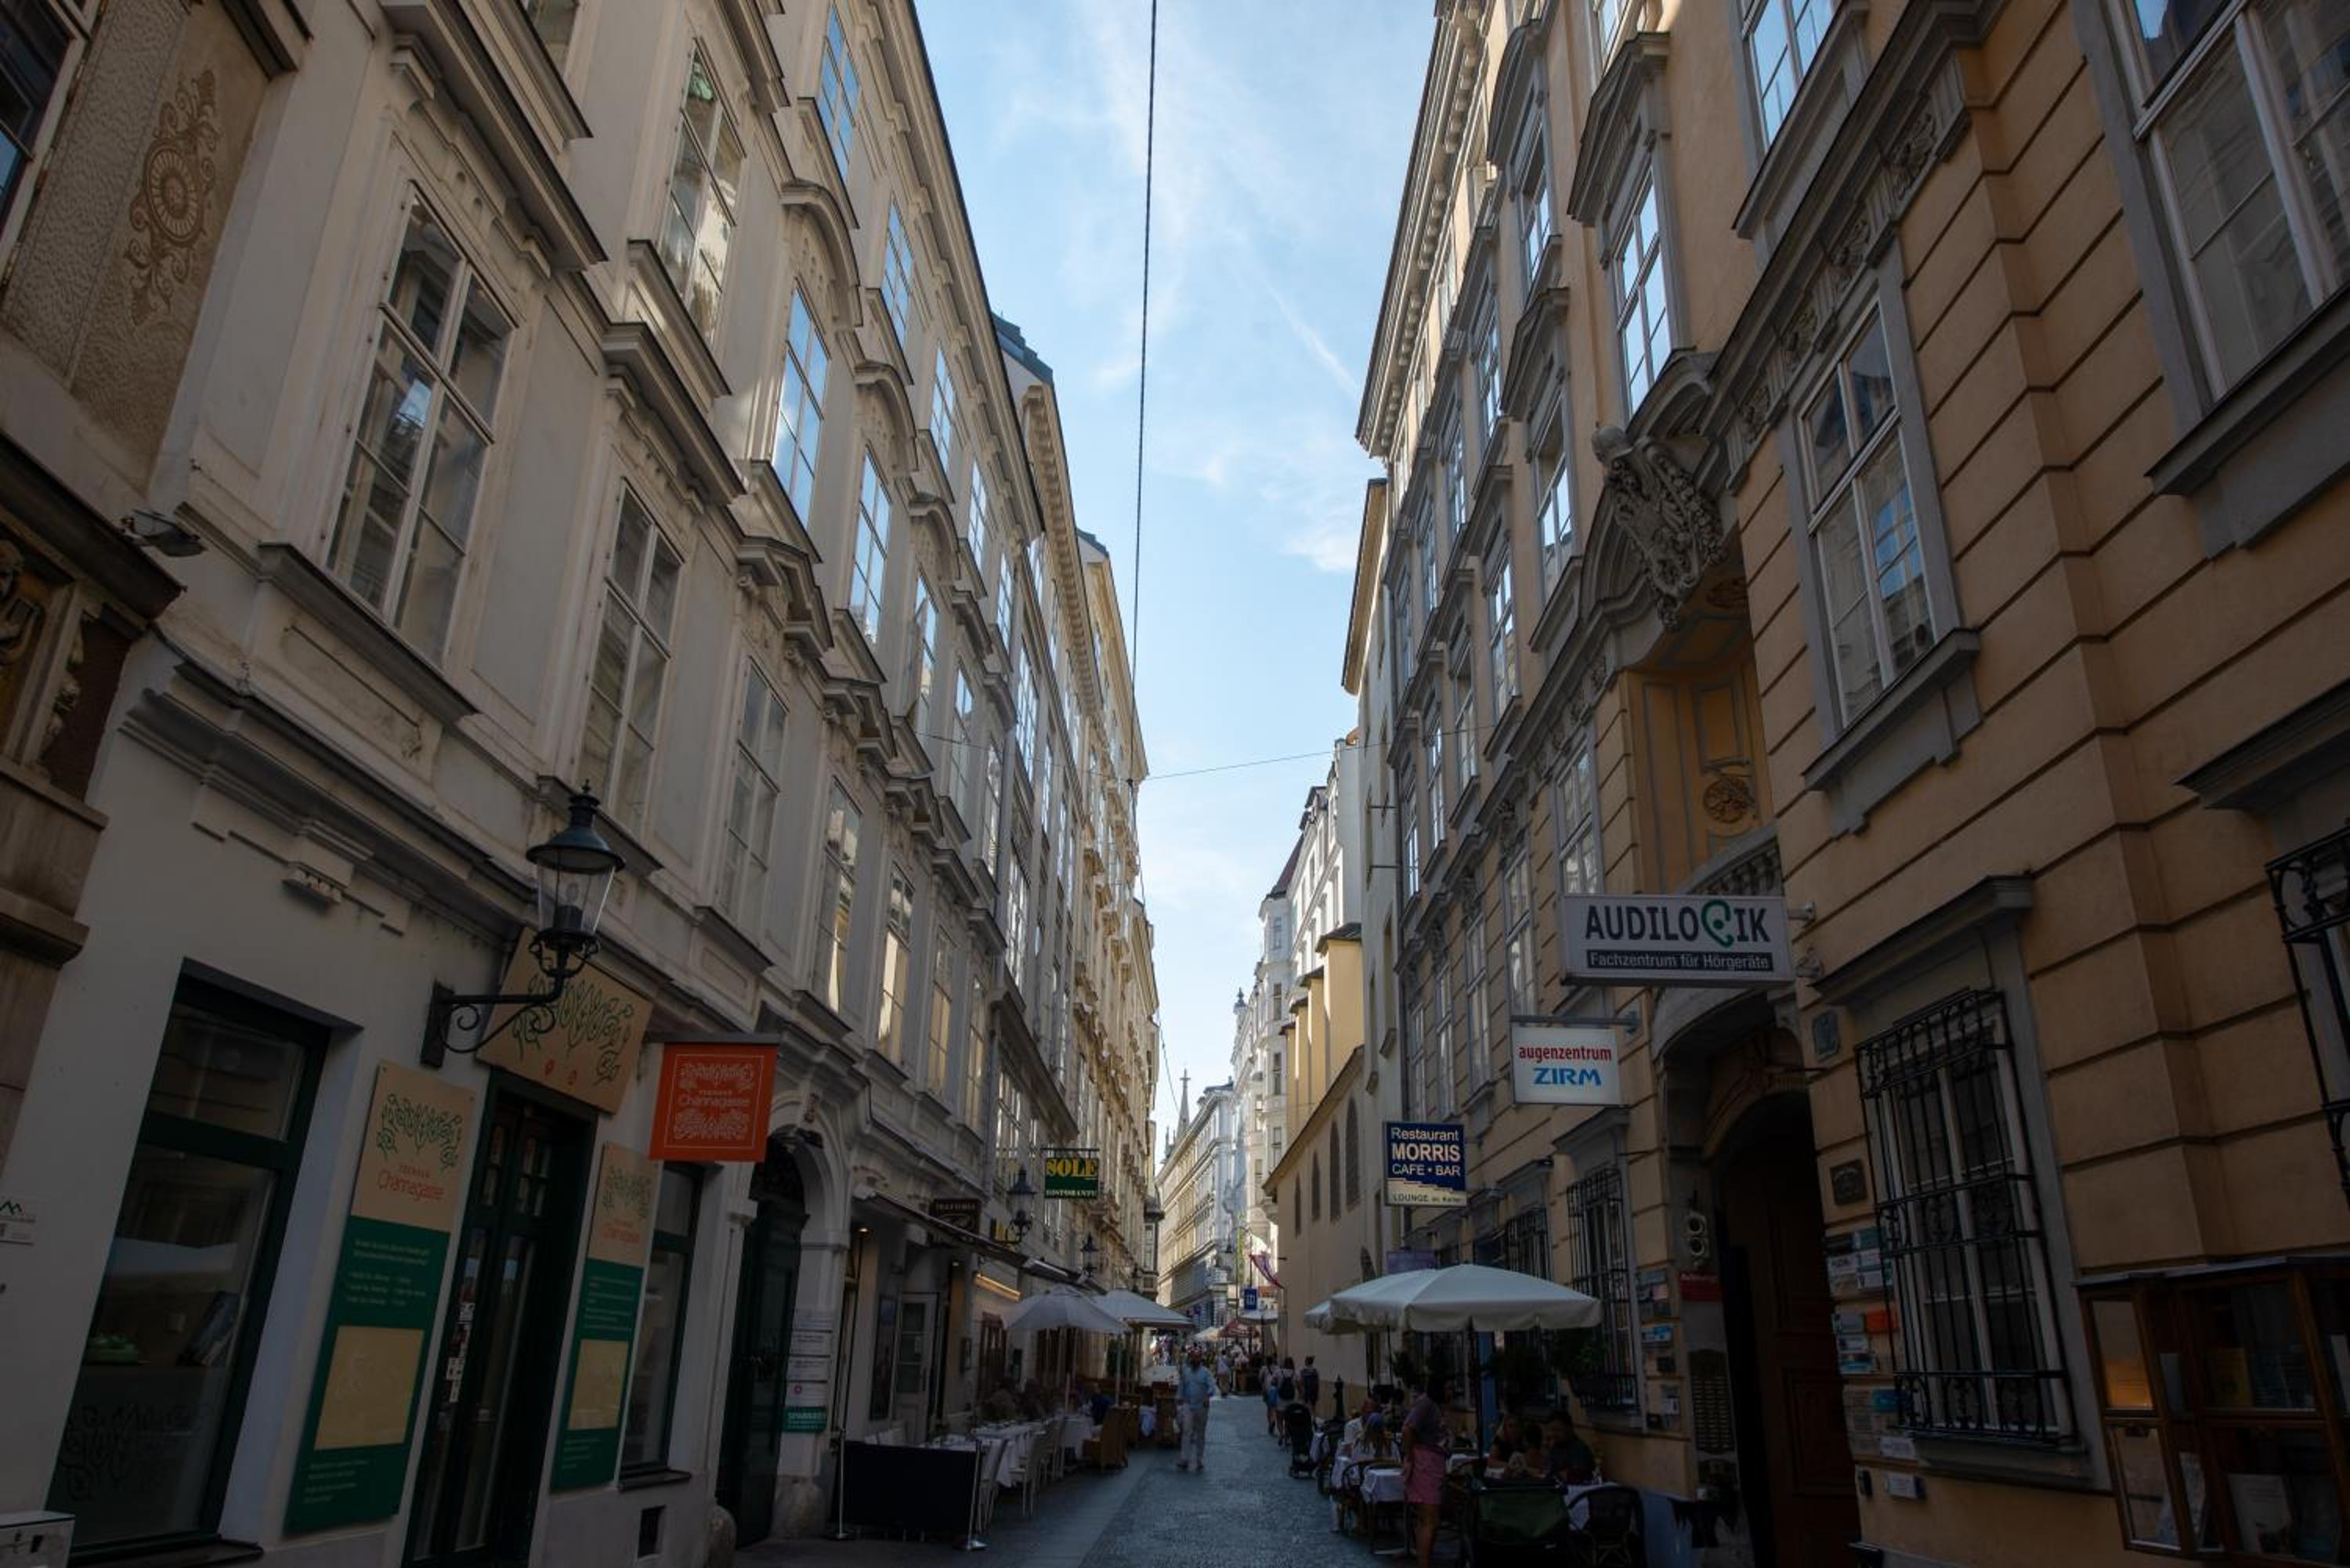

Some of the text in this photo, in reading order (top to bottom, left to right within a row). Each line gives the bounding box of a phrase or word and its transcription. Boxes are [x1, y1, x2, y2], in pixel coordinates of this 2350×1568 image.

[1590, 951, 1770, 972] Fachzentrum für Hörgeräte
[1519, 1046, 1611, 1064] augenzentrum
[1533, 1068, 1603, 1086] ZIRM
[1391, 1127, 1459, 1141] Restaurant
[1392, 1143, 1460, 1162] MORRIS
[1046, 1158, 1098, 1178] SOLE
[1392, 1163, 1461, 1177] CAFE BAR
[1393, 1193, 1429, 1202] LOUNGE
